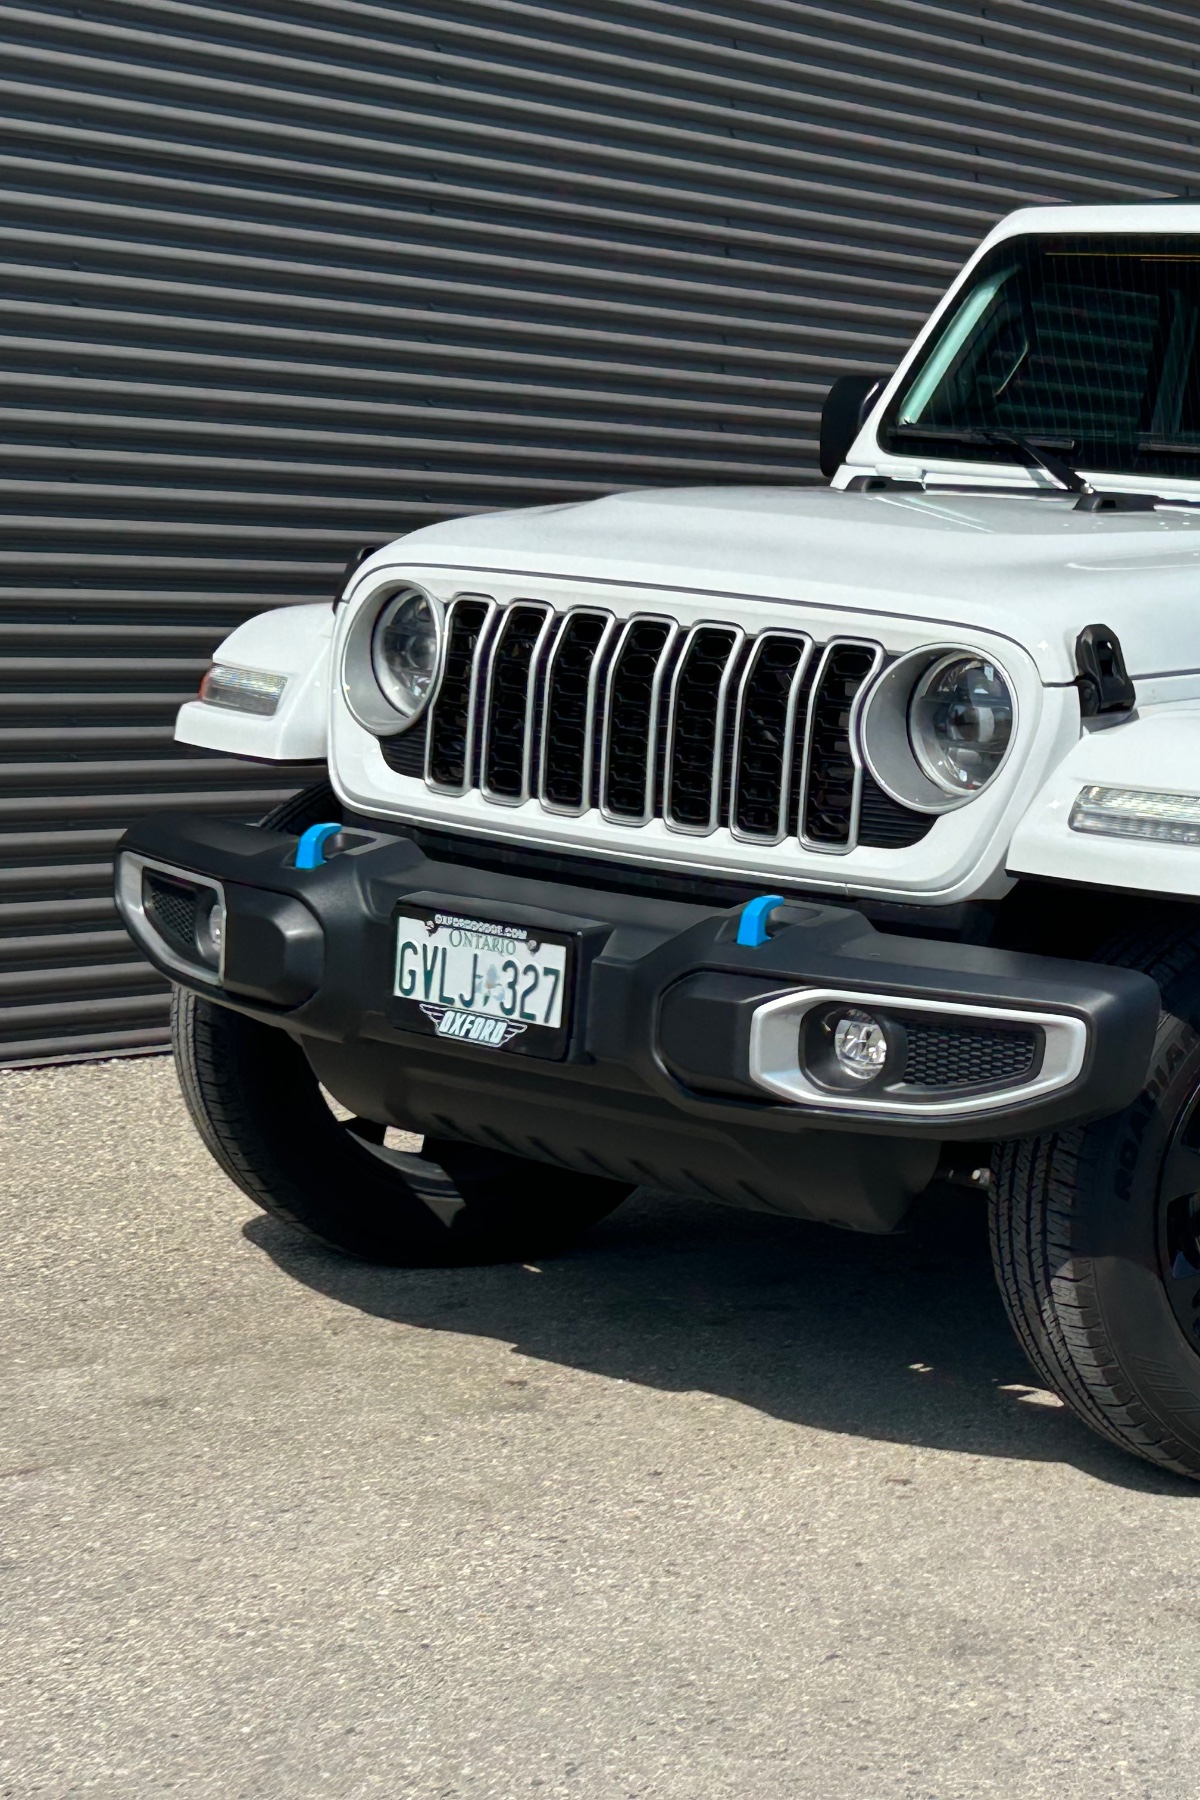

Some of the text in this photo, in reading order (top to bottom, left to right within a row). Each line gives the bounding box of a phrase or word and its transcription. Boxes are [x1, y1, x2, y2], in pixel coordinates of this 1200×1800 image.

[448, 928, 517, 956] ONTARIO
[398, 940, 561, 1024] GVLJ 327
[438, 1010, 509, 1045] OXFORD
